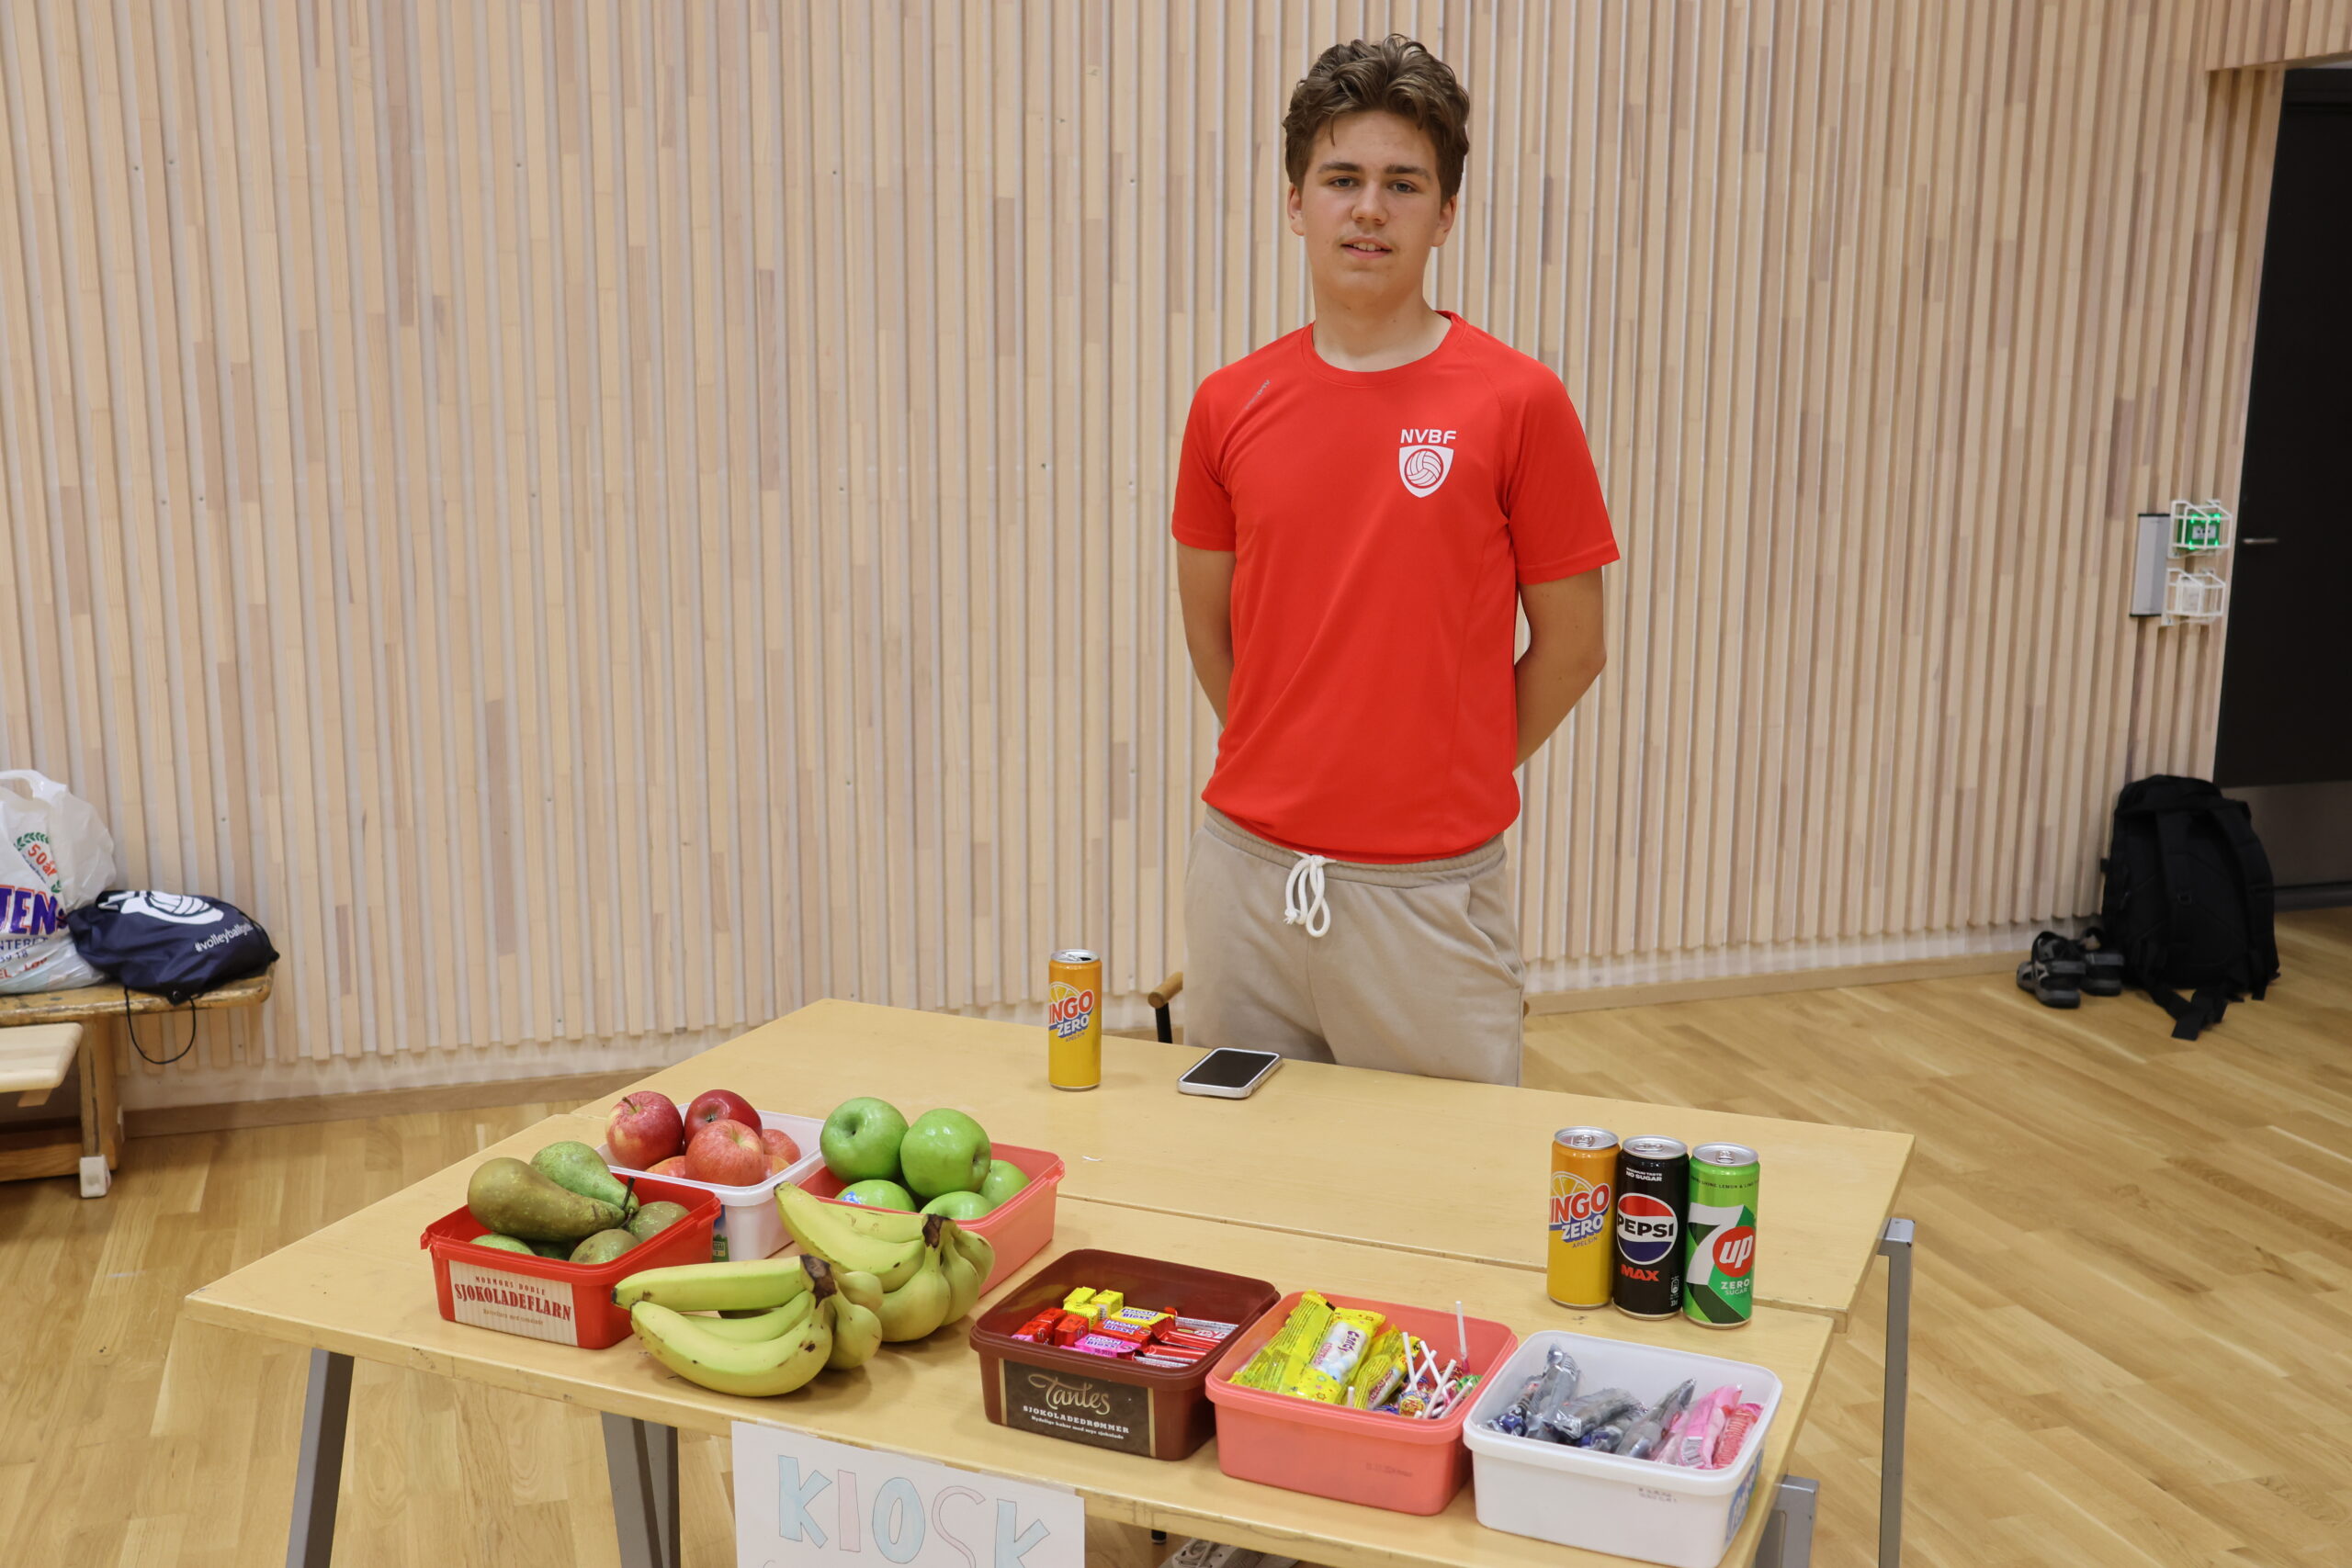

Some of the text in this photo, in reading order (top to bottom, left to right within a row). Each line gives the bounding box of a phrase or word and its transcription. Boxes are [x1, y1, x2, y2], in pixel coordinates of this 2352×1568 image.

[1400, 429, 1456, 445] NVBF
[1057, 1015, 1089, 1036] ZERO
[1561, 1214, 1604, 1240] ZERO
[1618, 1213, 1675, 1238] PEPSI
[1572, 1236, 1599, 1248] APELSIN
[1621, 1264, 1660, 1281] MAX
[475, 1276, 545, 1296] MORMORS DOBLE
[1721, 1279, 1750, 1290] ZERO
[454, 1283, 571, 1322] SJOKOLADEFLARN
[1123, 1313, 1152, 1321] Bloxx
[1103, 1325, 1135, 1334] Bloxx
[1086, 1340, 1118, 1349] Bloxx
[1028, 1373, 1111, 1416] Tantes
[1023, 1405, 1129, 1434] SJOKOLADEDRØMMER
[778, 1455, 1050, 1568] KIOSK
